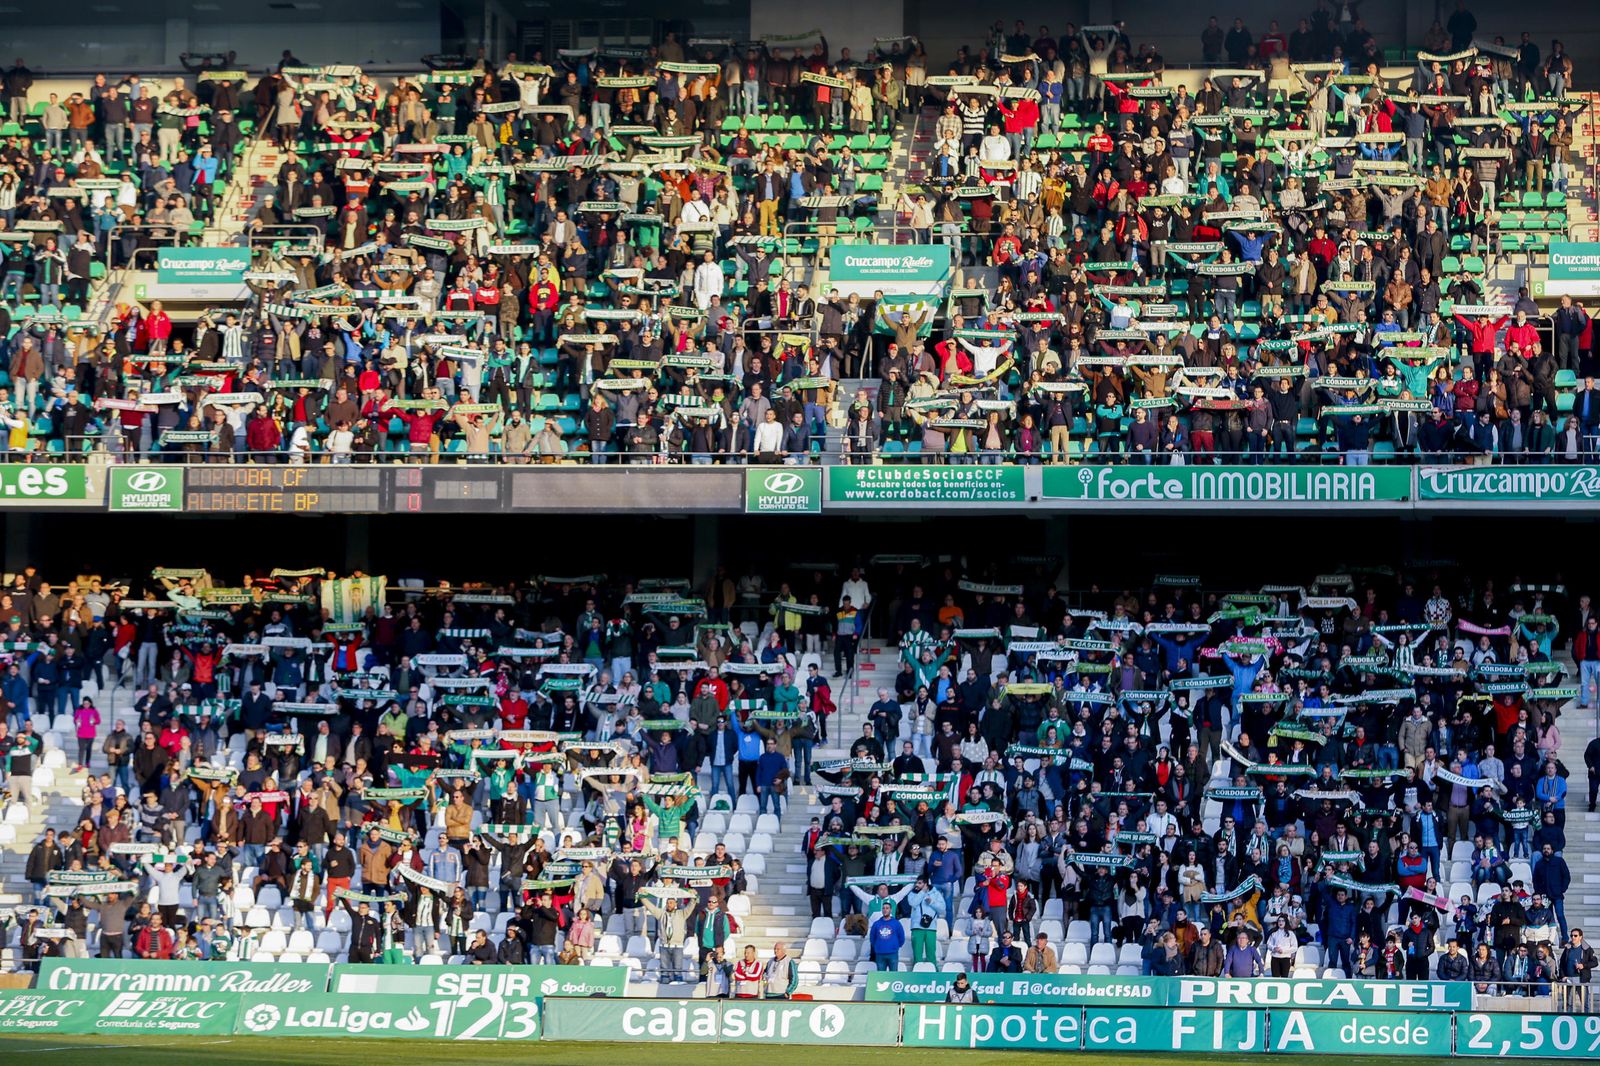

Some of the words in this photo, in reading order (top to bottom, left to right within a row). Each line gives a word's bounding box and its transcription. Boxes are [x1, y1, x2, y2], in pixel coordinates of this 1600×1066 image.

[161, 258, 214, 271] Cruzcampo
[845, 255, 900, 268] Cruzcampo
[901, 256, 934, 268] Radler
[137, 286, 145, 296] 4
[823, 284, 830, 295] 5
[1534, 284, 1541, 294] 6
[188, 468, 272, 486] CORDOBA
[283, 468, 307, 486] CF
[857, 469, 1003, 480] #ClubdeSociosCCF
[0, 467, 69, 496] .es
[1098, 467, 1183, 500] forte
[1191, 472, 1375, 500] INMOBILIARIA
[1430, 471, 1565, 498] Cruzcampo
[121, 494, 169, 502] HYUNDAI
[759, 496, 808, 504] HYUNDAI
[845, 488, 1016, 499] www.cordobacf.com/socios
[188, 493, 283, 511] ALBACETE
[294, 493, 318, 511] BP
[408, 493, 419, 511] 0
[1480, 665, 1513, 673] CÓRDOBA
[1125, 691, 1156, 699] CÓRDOBA
[896, 791, 935, 800] CÓRDOBA
[1077, 853, 1111, 863] CÓRDOBA
[674, 866, 708, 876] CÓRDOBA
[49, 966, 211, 991] Cruzcampo
[218, 970, 313, 992] Radler
[434, 973, 531, 997] SEUR
[561, 982, 617, 995] dpdgroup
[891, 980, 1004, 995] @cordobfsad
[1030, 982, 1152, 998] @CordobaCFSAD
[1180, 980, 1460, 1006] PROCATEL
[2, 1000, 85, 1017] PACC
[138, 1001, 226, 1019] PACC
[15, 1019, 59, 1029] Seguros
[145, 1019, 157, 1028] de
[158, 1020, 201, 1030] Seguros
[285, 1005, 392, 1033] LaLiga
[622, 1000, 802, 1041] cajasur
[917, 1005, 1137, 1048] Hipoteca
[1172, 1009, 1314, 1050] FIJA
[1340, 1018, 1429, 1046] desde
